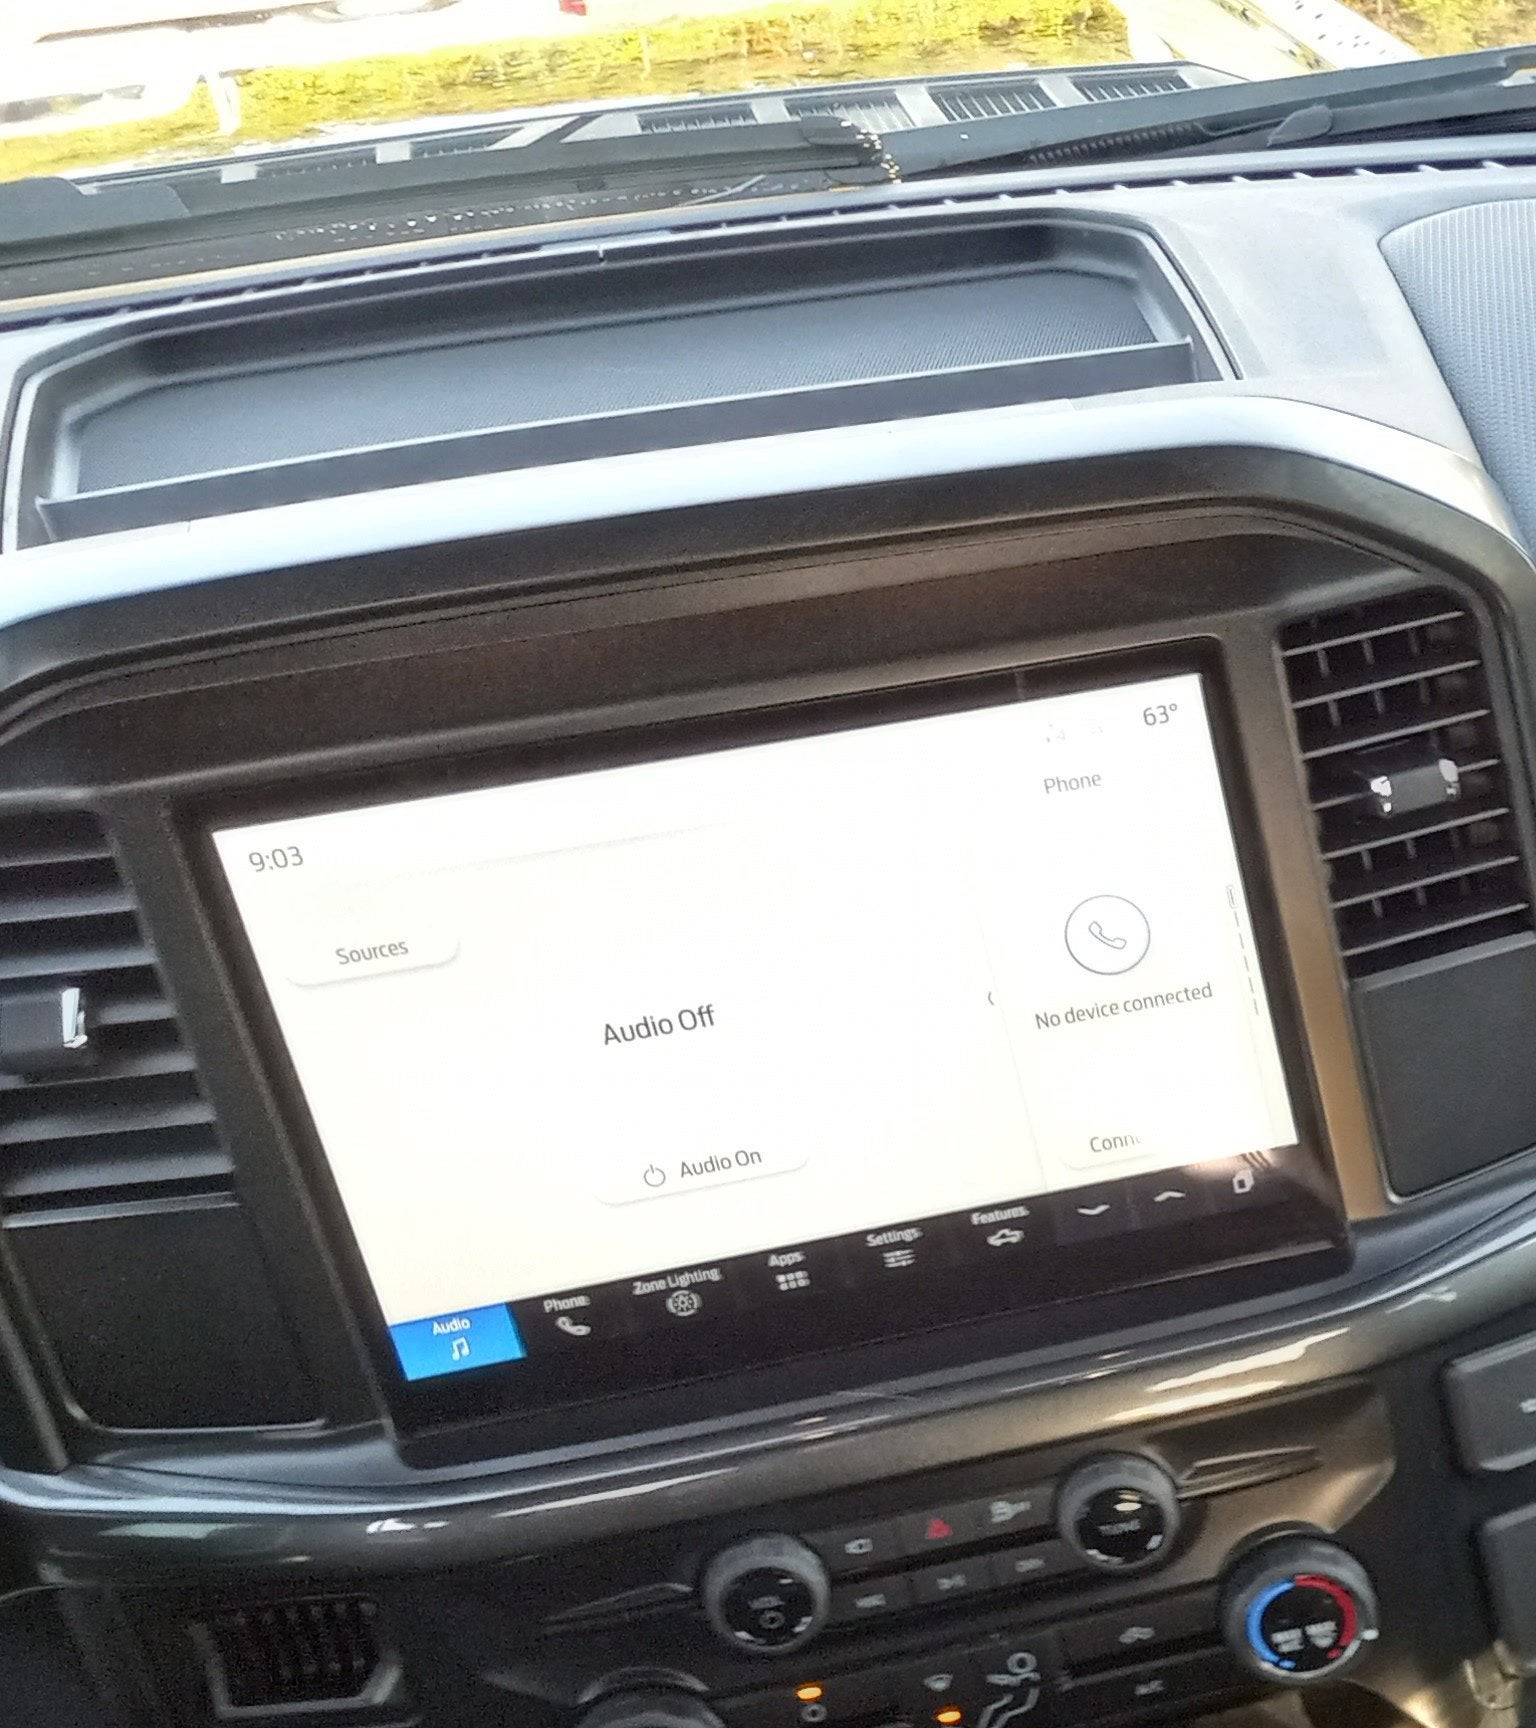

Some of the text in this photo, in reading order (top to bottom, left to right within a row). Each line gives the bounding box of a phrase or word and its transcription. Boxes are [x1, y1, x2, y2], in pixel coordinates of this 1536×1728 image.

[1043, 771, 1103, 796] Phone
[248, 845, 305, 873] 9:03
[335, 939, 410, 966] Sources
[1034, 982, 1214, 1030] No device connected
[603, 1003, 716, 1047] Audio Off
[1090, 1134, 1141, 1153] Conn
[679, 1146, 763, 1180] Audio On
[866, 1226, 920, 1250] Settings
[769, 1252, 803, 1272] Apps
[633, 1264, 720, 1296] Zone Lighting
[543, 1294, 588, 1314] Phone
[432, 1315, 471, 1337] Audio
